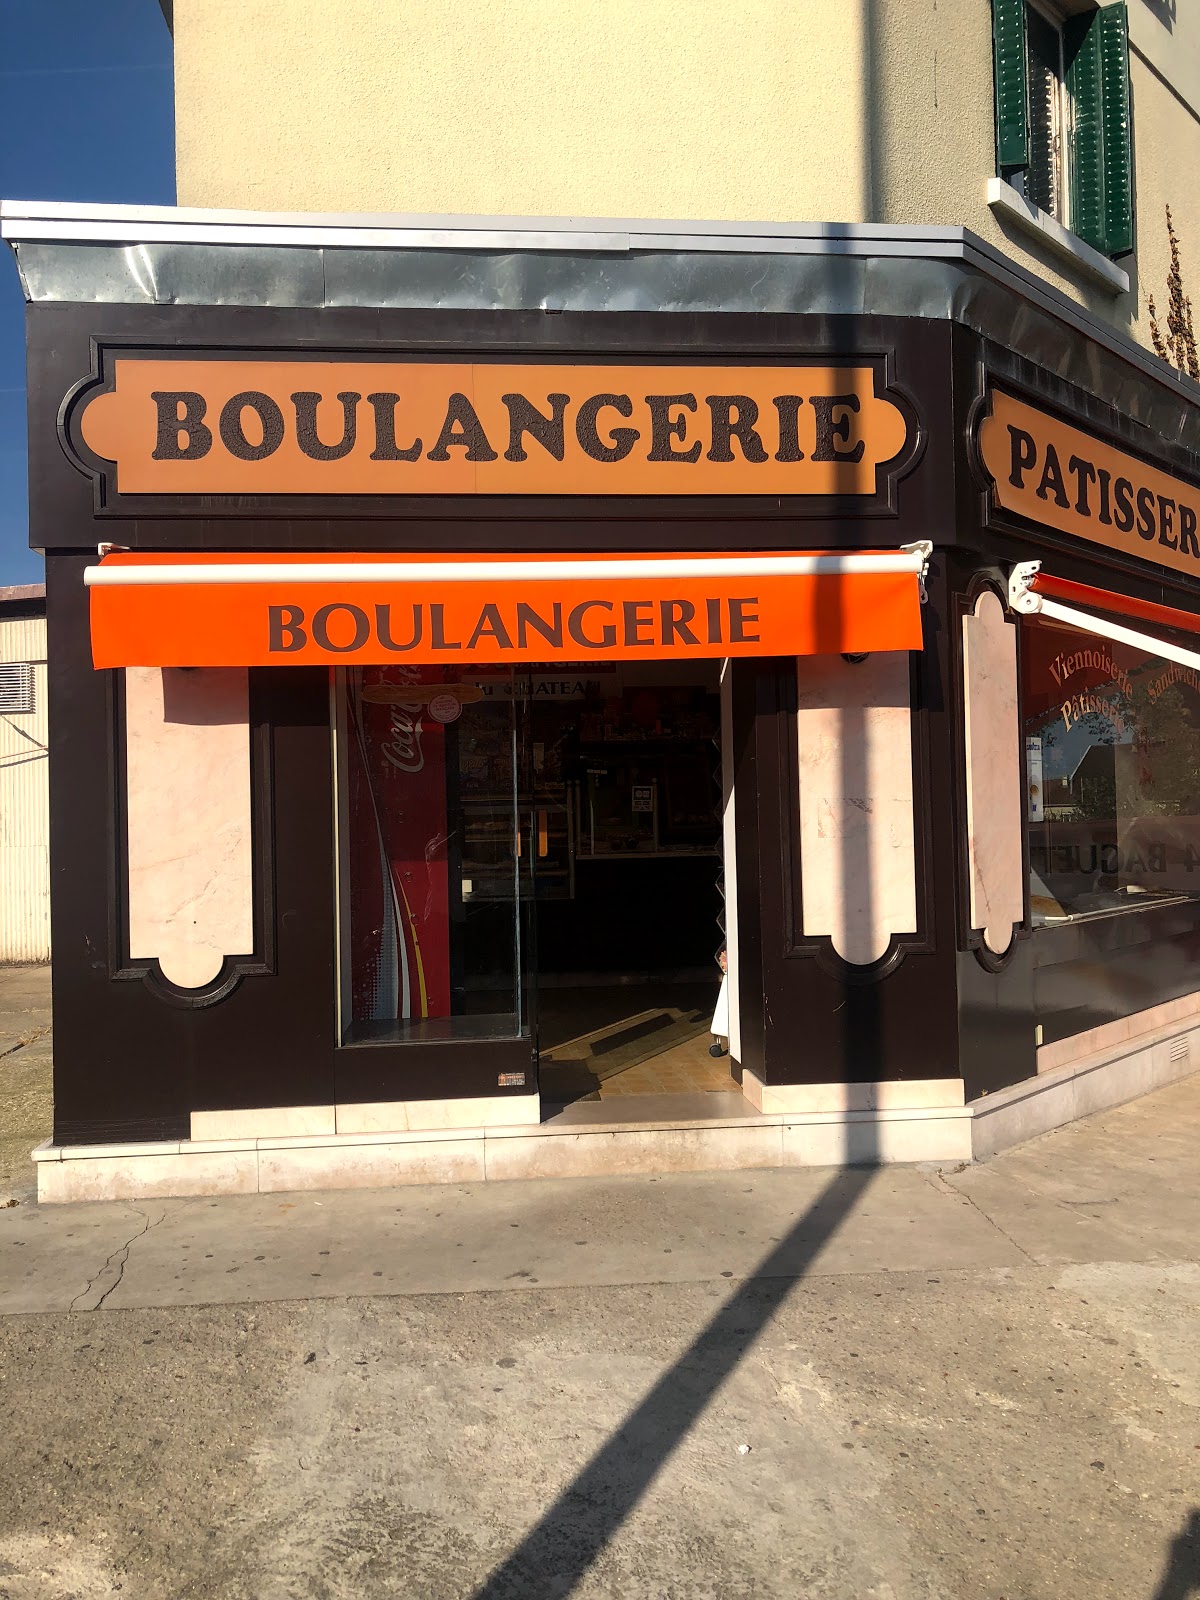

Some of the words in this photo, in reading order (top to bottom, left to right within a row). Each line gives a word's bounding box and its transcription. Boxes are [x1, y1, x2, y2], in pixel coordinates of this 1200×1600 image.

[151, 391, 865, 463] BOULANGERIE
[1007, 423, 1200, 559] PATISSER
[268, 597, 761, 653] BOULANGERIE
[1049, 645, 1133, 701] Viennoiserie
[1060, 686, 1125, 735] Pâtisserie
